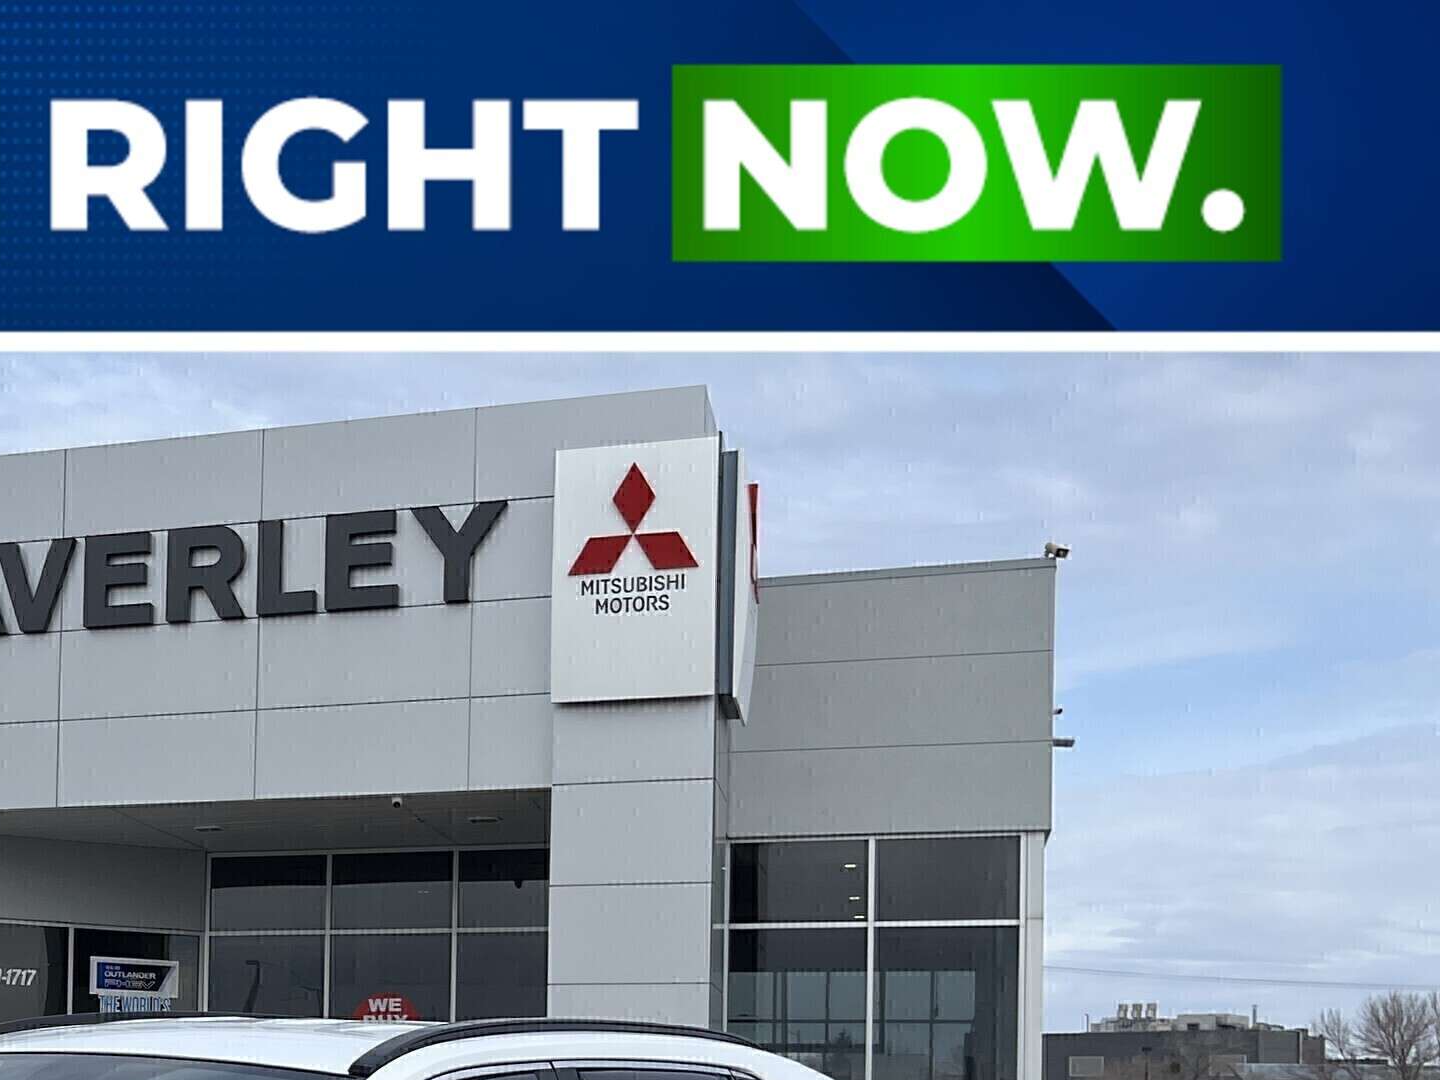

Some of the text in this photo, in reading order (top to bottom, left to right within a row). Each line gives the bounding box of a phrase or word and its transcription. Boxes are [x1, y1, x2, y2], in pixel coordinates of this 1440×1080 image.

[580, 573, 686, 596] MITSUBISHI
[595, 594, 670, 615] MOTORS
[104, 970, 156, 980] OUTLANDER
[100, 995, 120, 1013] THE
[368, 998, 402, 1013] WE
